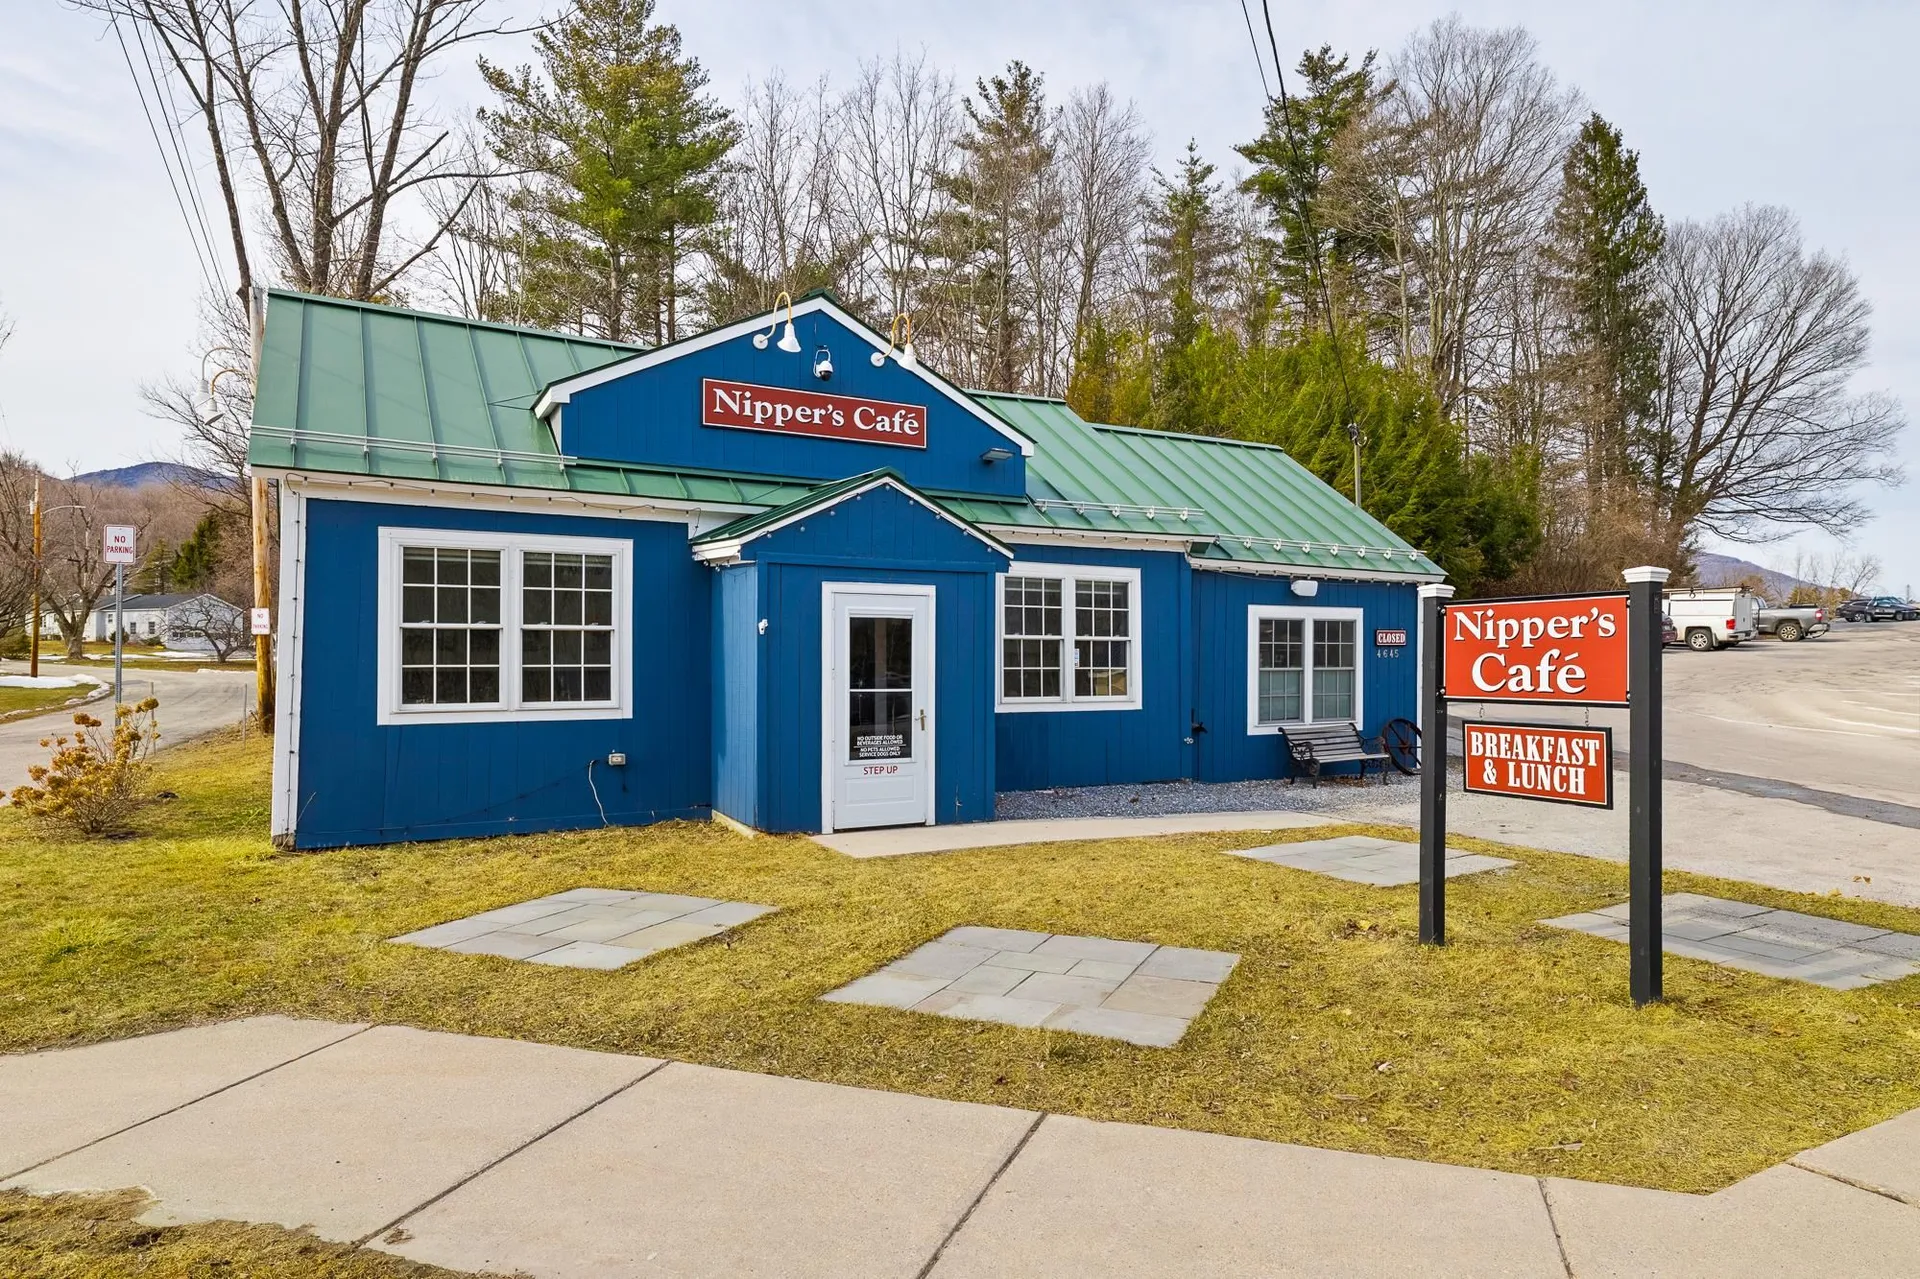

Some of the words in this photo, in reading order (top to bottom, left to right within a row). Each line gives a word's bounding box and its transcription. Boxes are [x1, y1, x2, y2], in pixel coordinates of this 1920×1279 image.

[713, 388, 845, 427] Nipper's
[853, 406, 919, 435] Café
[107, 545, 133, 554] PARKING
[114, 535, 126, 543] NO
[1378, 633, 1406, 643] CLOSED
[1453, 607, 1616, 648] Nipper's
[1376, 649, 1400, 658] 4645
[1471, 649, 1586, 694] Café
[1470, 731, 1600, 767] BREAKFAST
[863, 766, 884, 775] STEP
[886, 765, 898, 774] UP
[1483, 758, 1497, 785] &
[1508, 761, 1586, 795] LUNCH
